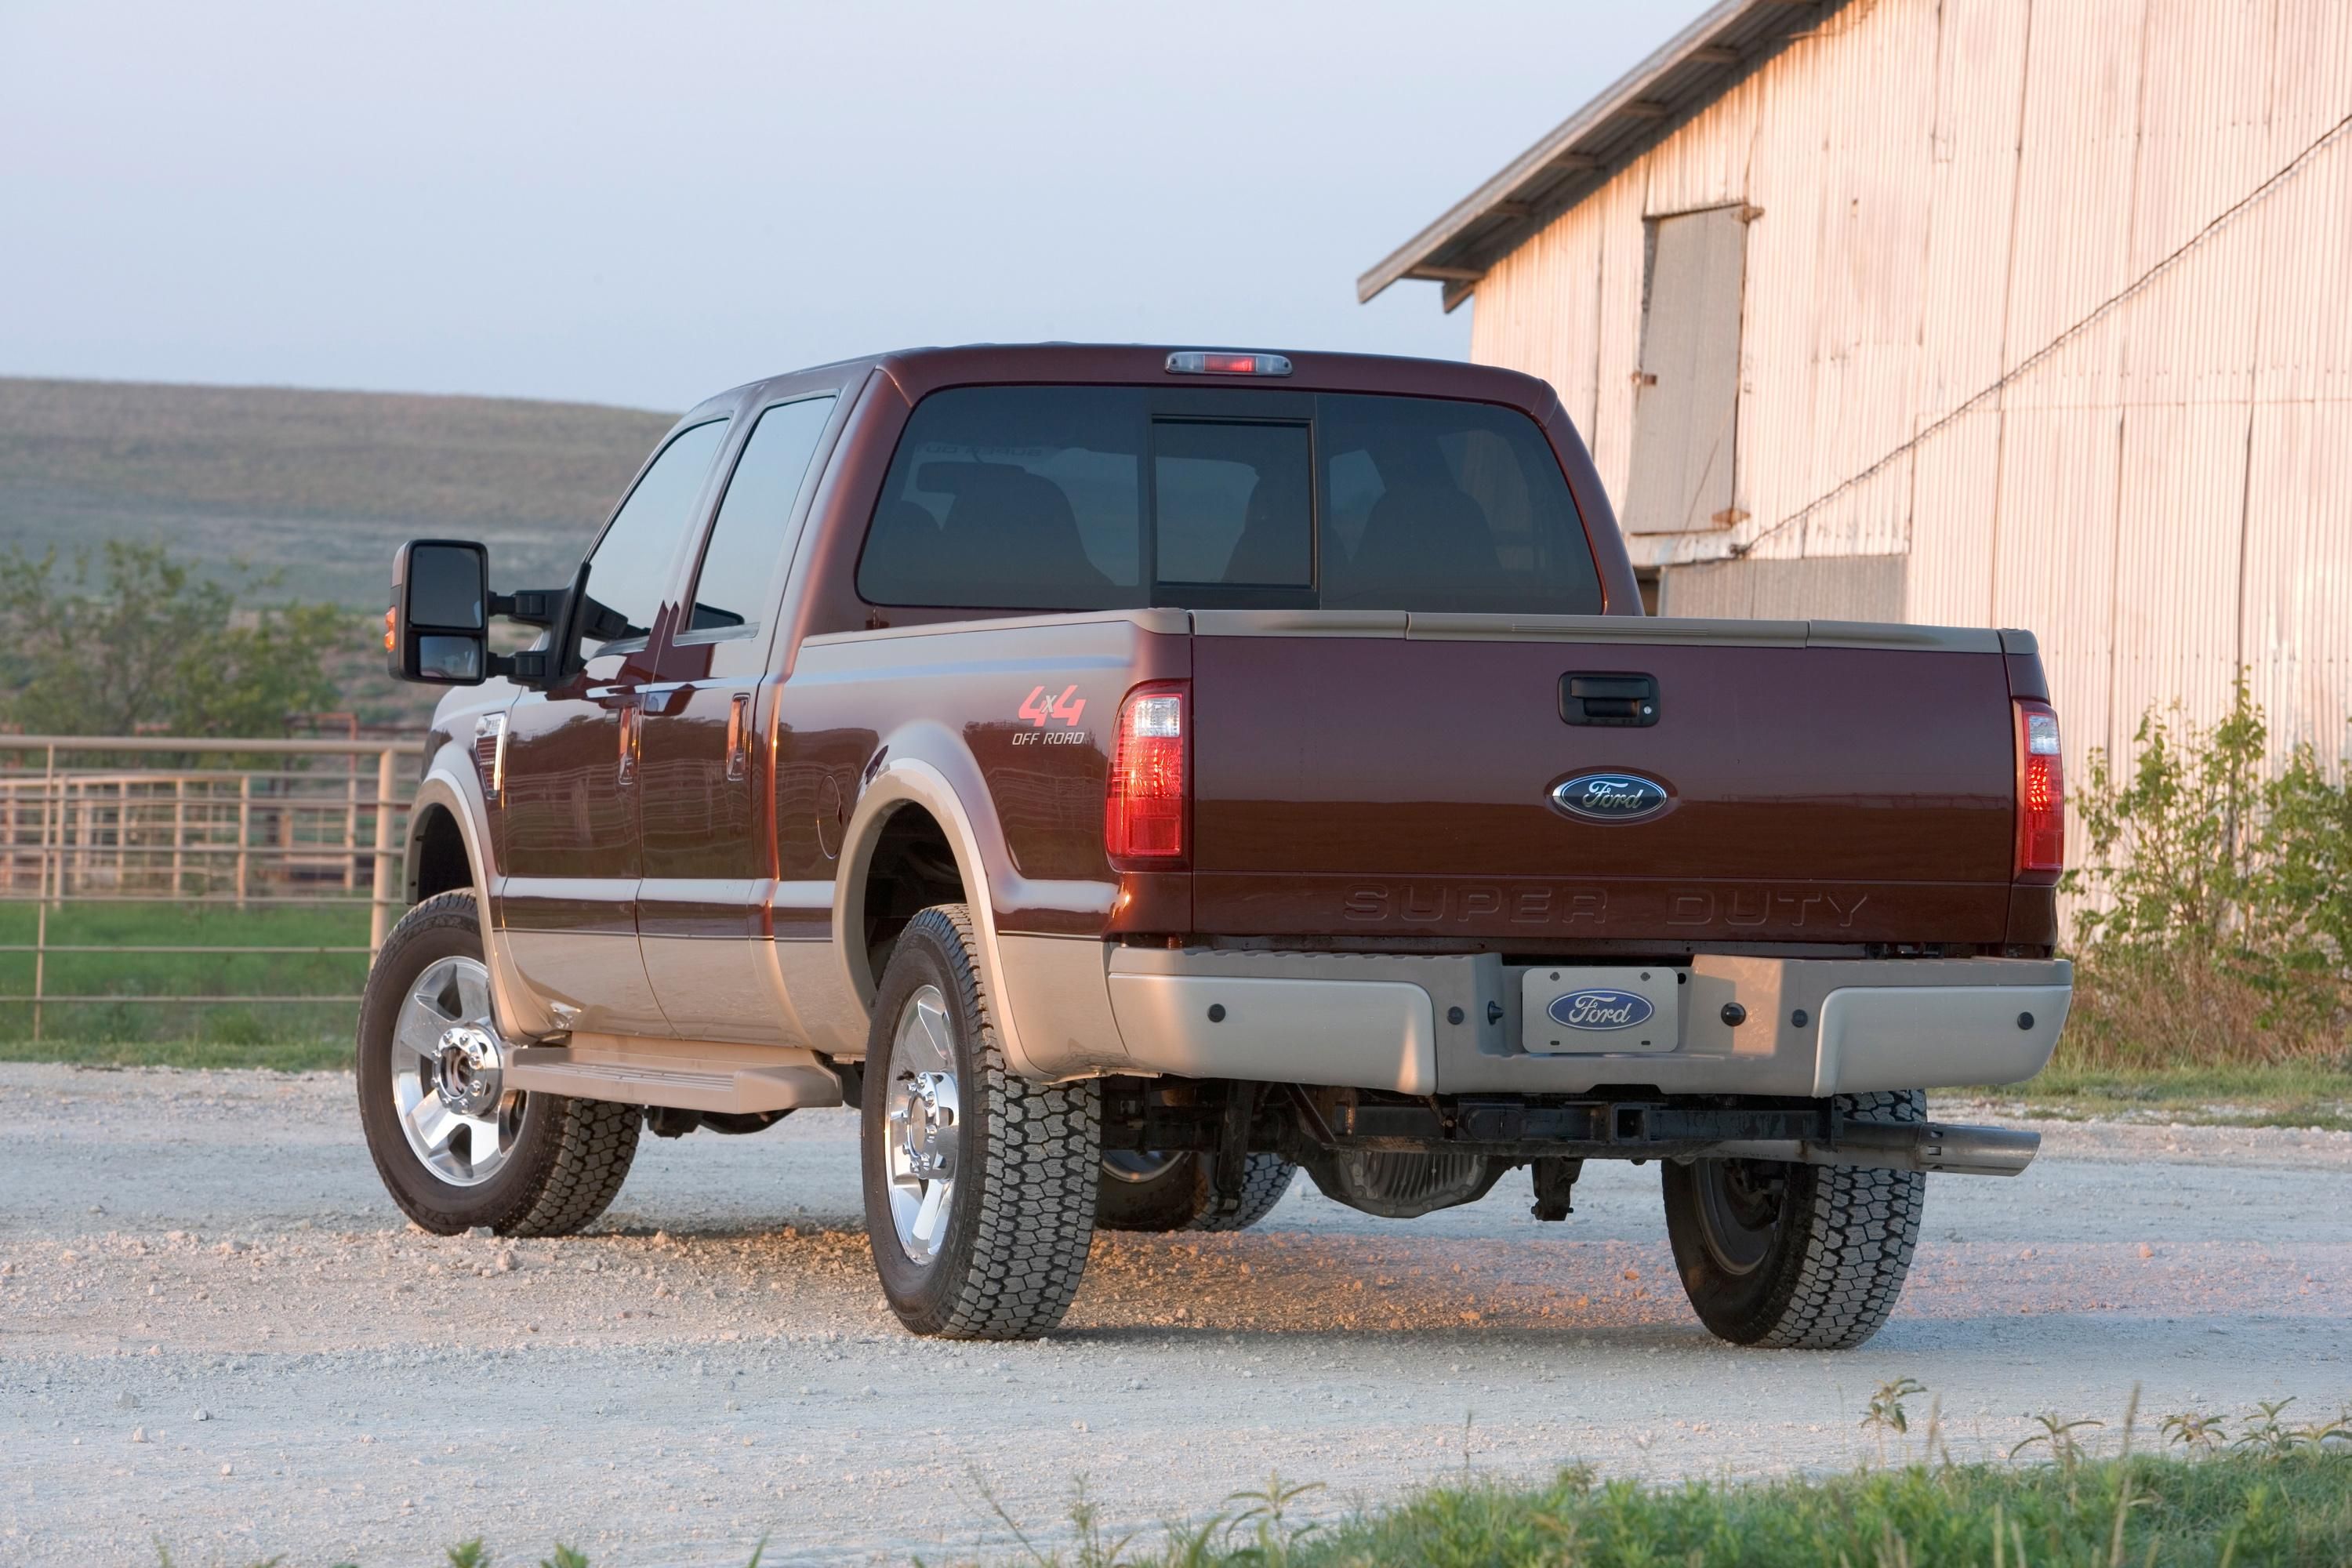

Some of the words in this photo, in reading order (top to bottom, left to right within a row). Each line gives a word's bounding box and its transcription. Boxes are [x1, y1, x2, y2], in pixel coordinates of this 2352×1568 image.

[1012, 733, 1040, 745] OFF
[1043, 731, 1085, 745] ROAD
[1582, 781, 1644, 808] Ford
[1343, 884, 1606, 923] SUPER
[1666, 888, 1869, 927] DUTY
[1569, 995, 1632, 1023] Ford
